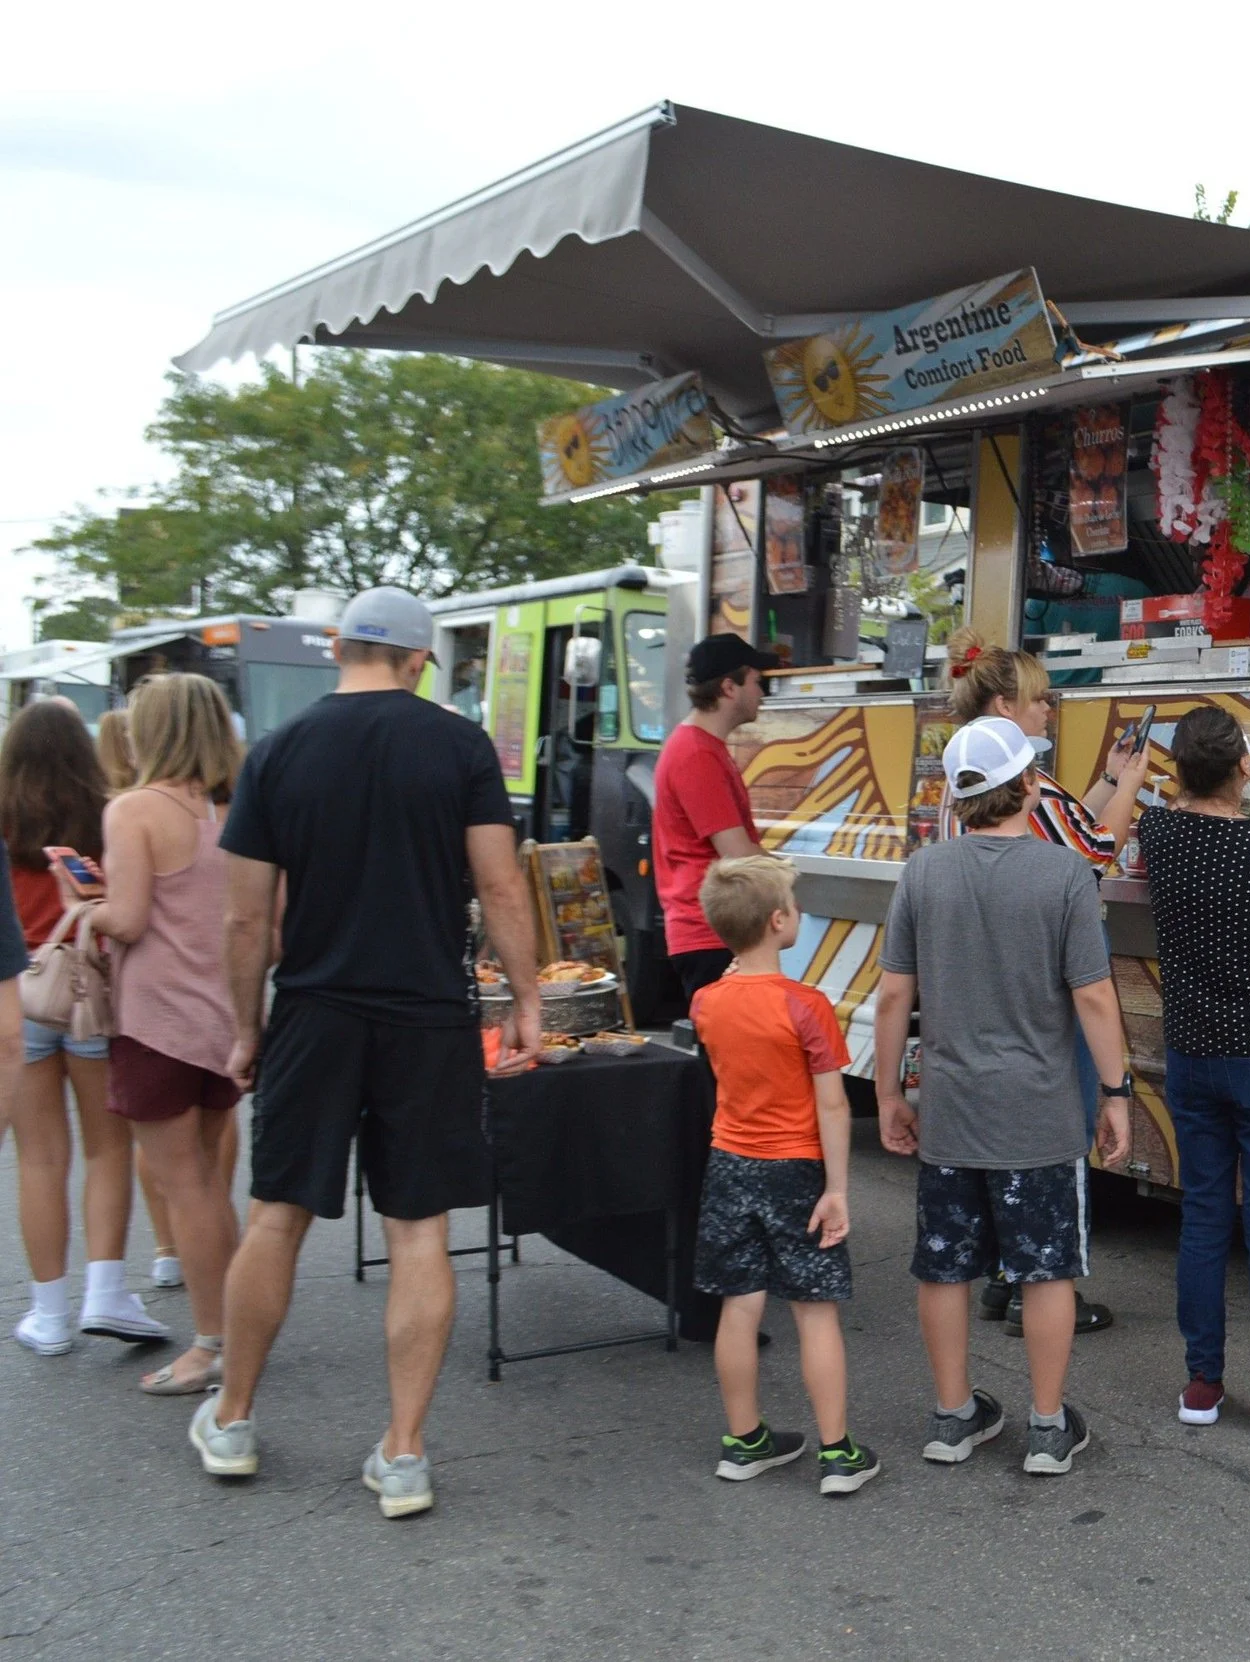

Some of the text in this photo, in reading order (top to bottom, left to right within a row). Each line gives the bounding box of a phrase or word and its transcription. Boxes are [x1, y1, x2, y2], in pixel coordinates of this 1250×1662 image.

[892, 301, 1012, 356] Argentine
[904, 339, 1028, 390] Comfort Food
[1074, 425, 1125, 449] Churros
